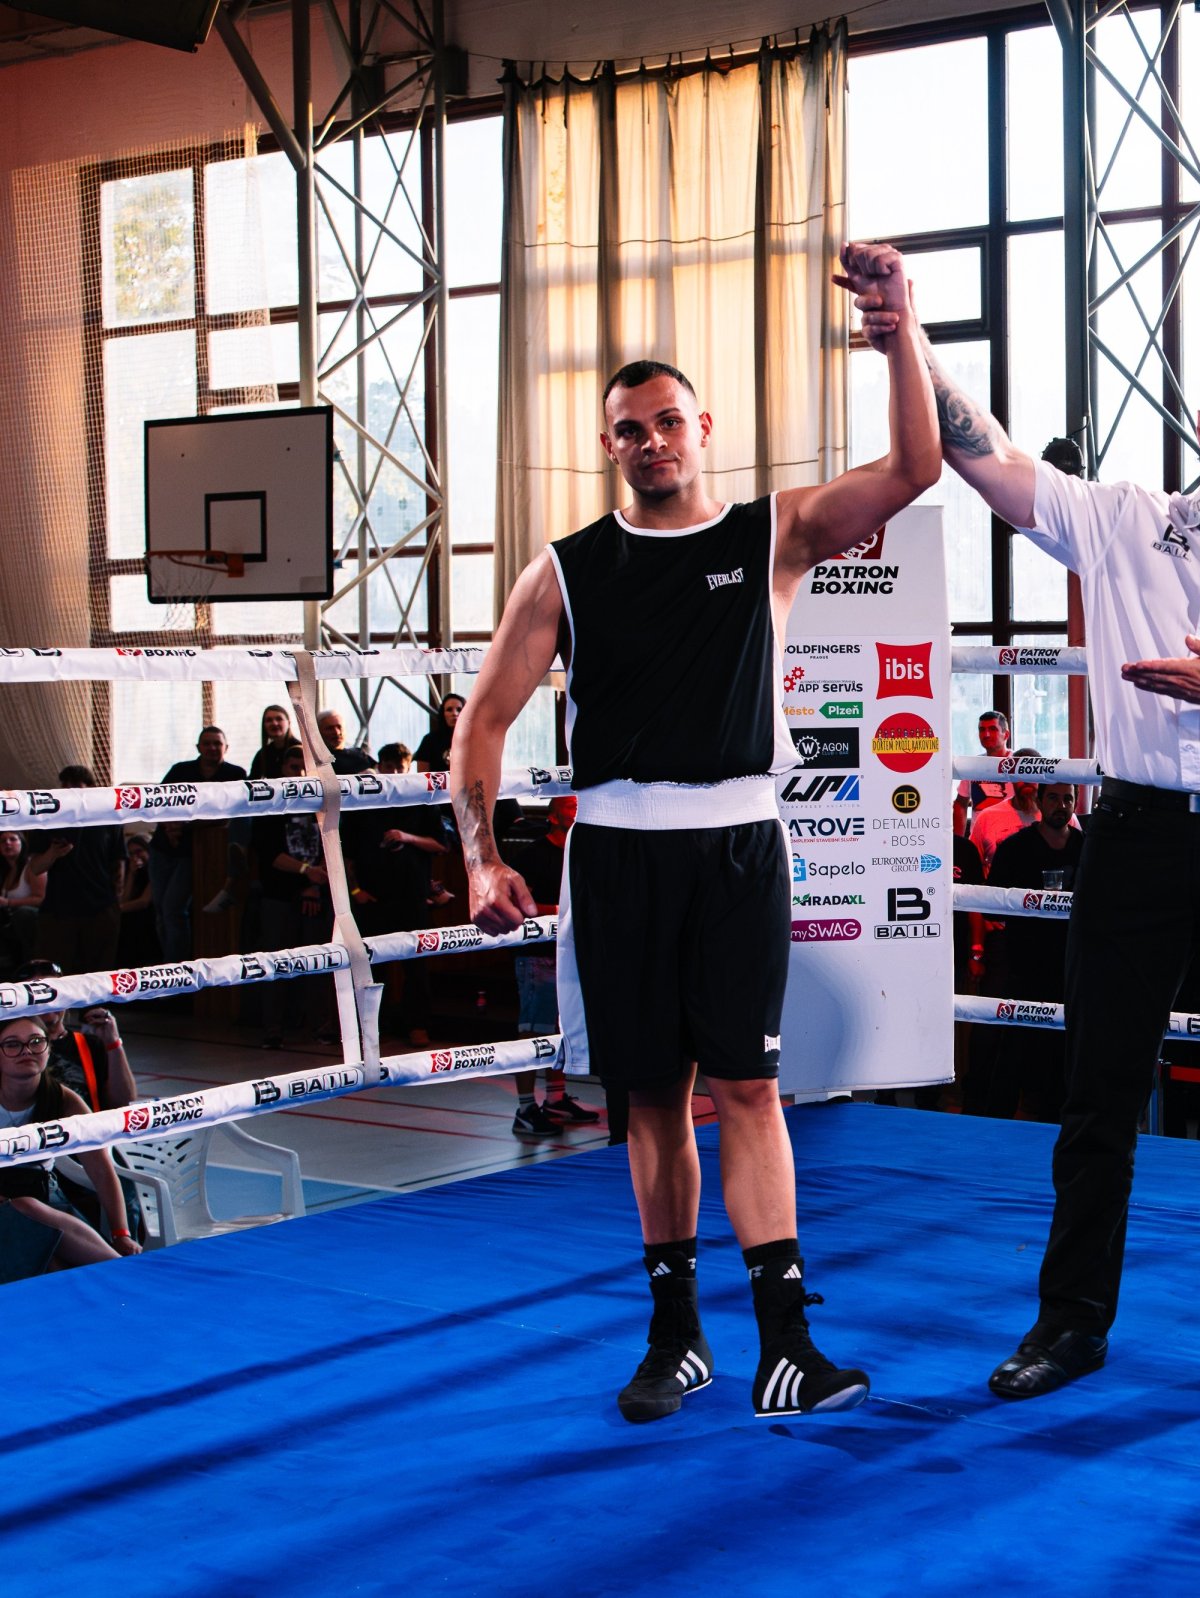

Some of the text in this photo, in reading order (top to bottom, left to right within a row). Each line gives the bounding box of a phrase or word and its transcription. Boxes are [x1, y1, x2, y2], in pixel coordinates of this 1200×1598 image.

[705, 567, 744, 591] EVERLAST
[813, 565, 899, 579] PATRON
[810, 581, 894, 595] BOXING
[1020, 648, 1062, 657] PATRON
[885, 657, 925, 680] ibis
[1019, 657, 1058, 666] BOXING
[798, 683, 820, 693] APP
[823, 680, 863, 693] servis
[828, 705, 860, 716] Plzeň
[1018, 765, 1056, 775] BOXING
[143, 784, 198, 796] PATRON
[143, 795, 196, 809] BOXING
[783, 817, 865, 837] AROVE
[872, 817, 940, 830] DETAILING
[891, 835, 925, 847] BOSS
[871, 856, 919, 866] EURONOVA
[808, 861, 866, 879] Sapelo
[890, 864, 919, 873] GROUP
[790, 920, 858, 941] mySWAG
[874, 923, 940, 939] BAIL
[440, 937, 483, 951] BOXING
[273, 951, 343, 974] BAIL
[139, 964, 194, 980] PATRON
[138, 976, 193, 993] BOXING
[1017, 1004, 1058, 1016] PATRON
[454, 1045, 496, 1059] PATRON
[454, 1056, 495, 1070] BOXING
[289, 1069, 358, 1097] BAIL
[151, 1095, 205, 1116] PATRON
[151, 1107, 204, 1129] BOXING
